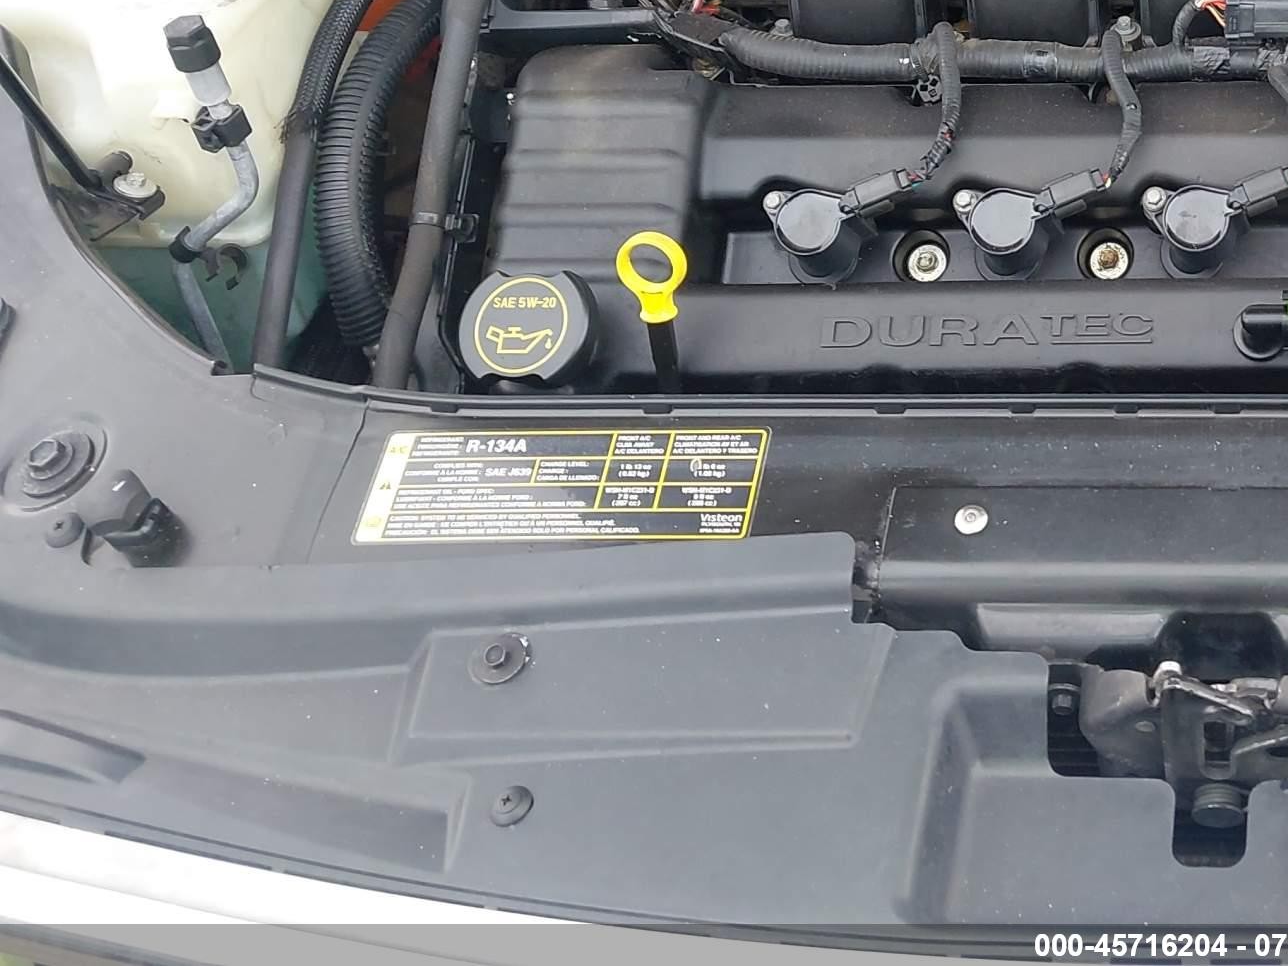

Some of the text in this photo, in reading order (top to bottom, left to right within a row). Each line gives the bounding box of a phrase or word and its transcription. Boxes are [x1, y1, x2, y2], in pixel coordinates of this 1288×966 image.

[493, 296, 557, 309] SAE 5W-20
[819, 312, 1154, 348] DURATEC
[466, 440, 527, 453] R-134A
[485, 468, 506, 476] SAE
[700, 513, 742, 522] Visteon
